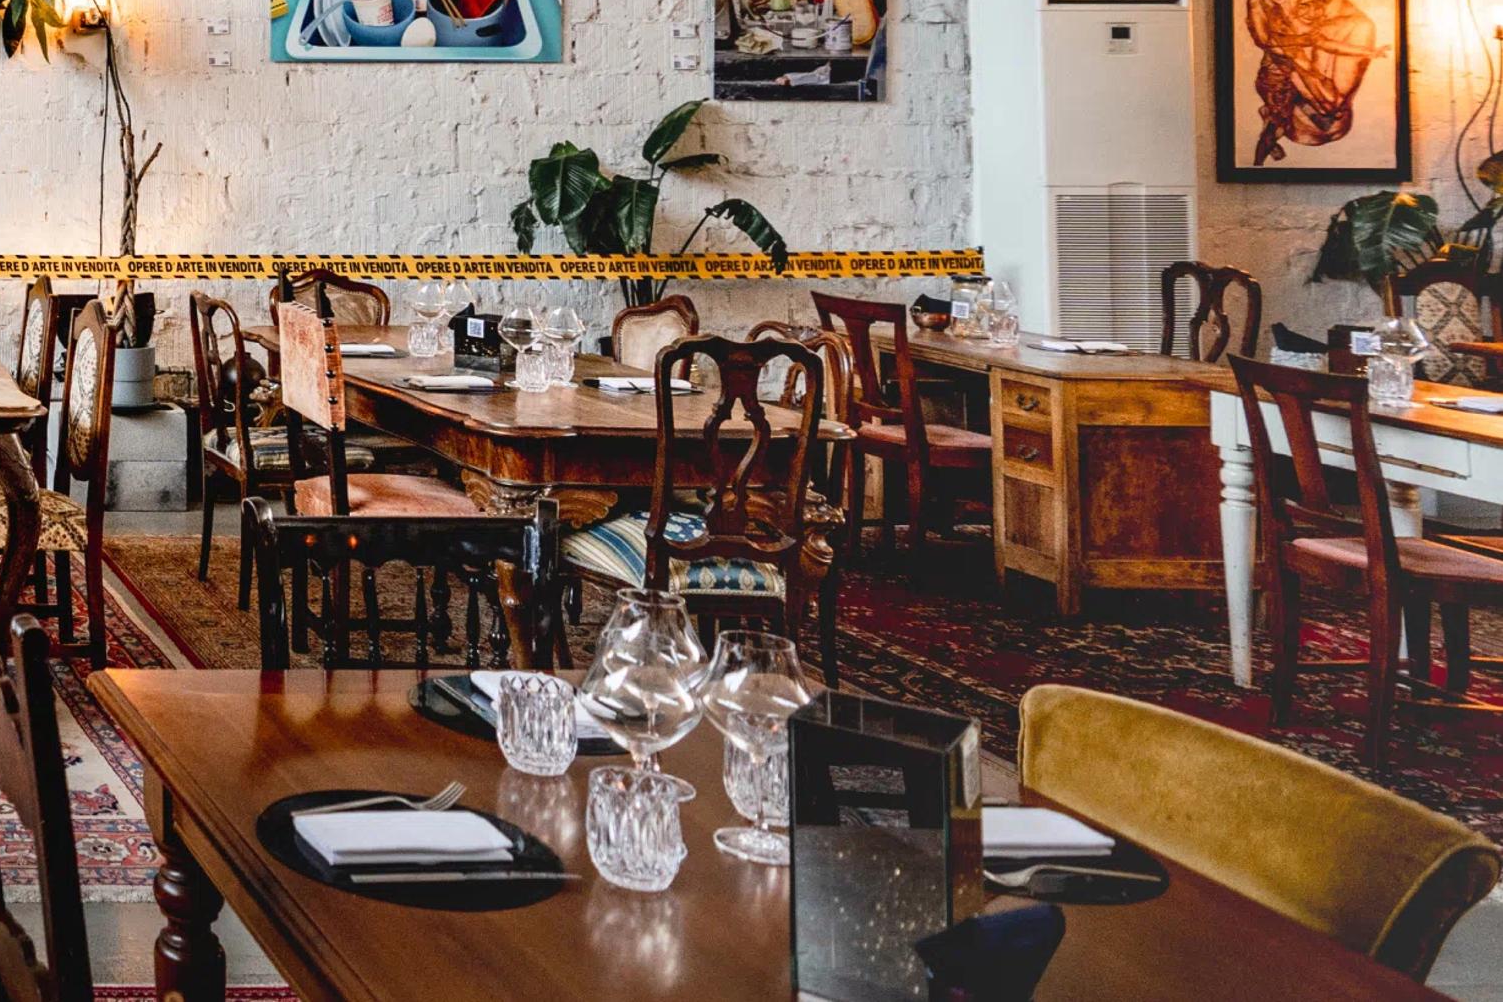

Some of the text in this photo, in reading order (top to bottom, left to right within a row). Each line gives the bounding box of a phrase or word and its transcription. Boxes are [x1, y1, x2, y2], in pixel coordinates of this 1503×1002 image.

[62, 261, 72, 273] IN
[75, 261, 120, 273] VENDITA
[128, 261, 163, 273] OPERE
[205, 261, 216, 273] IN
[218, 261, 264, 273] VENDITA
[349, 261, 360, 274] IN
[362, 261, 409, 274] VENDITA
[416, 261, 451, 274] OPERE
[494, 261, 504, 274] IN
[507, 261, 553, 274] VENDITA
[560, 261, 596, 274] OPERE
[638, 261, 648, 273] IN
[651, 260, 698, 273] VENDITA
[705, 260, 741, 273] OPERE
[796, 259, 843, 272] VENDITA
[850, 258, 886, 271] OPERE
[928, 257, 939, 270] IN
